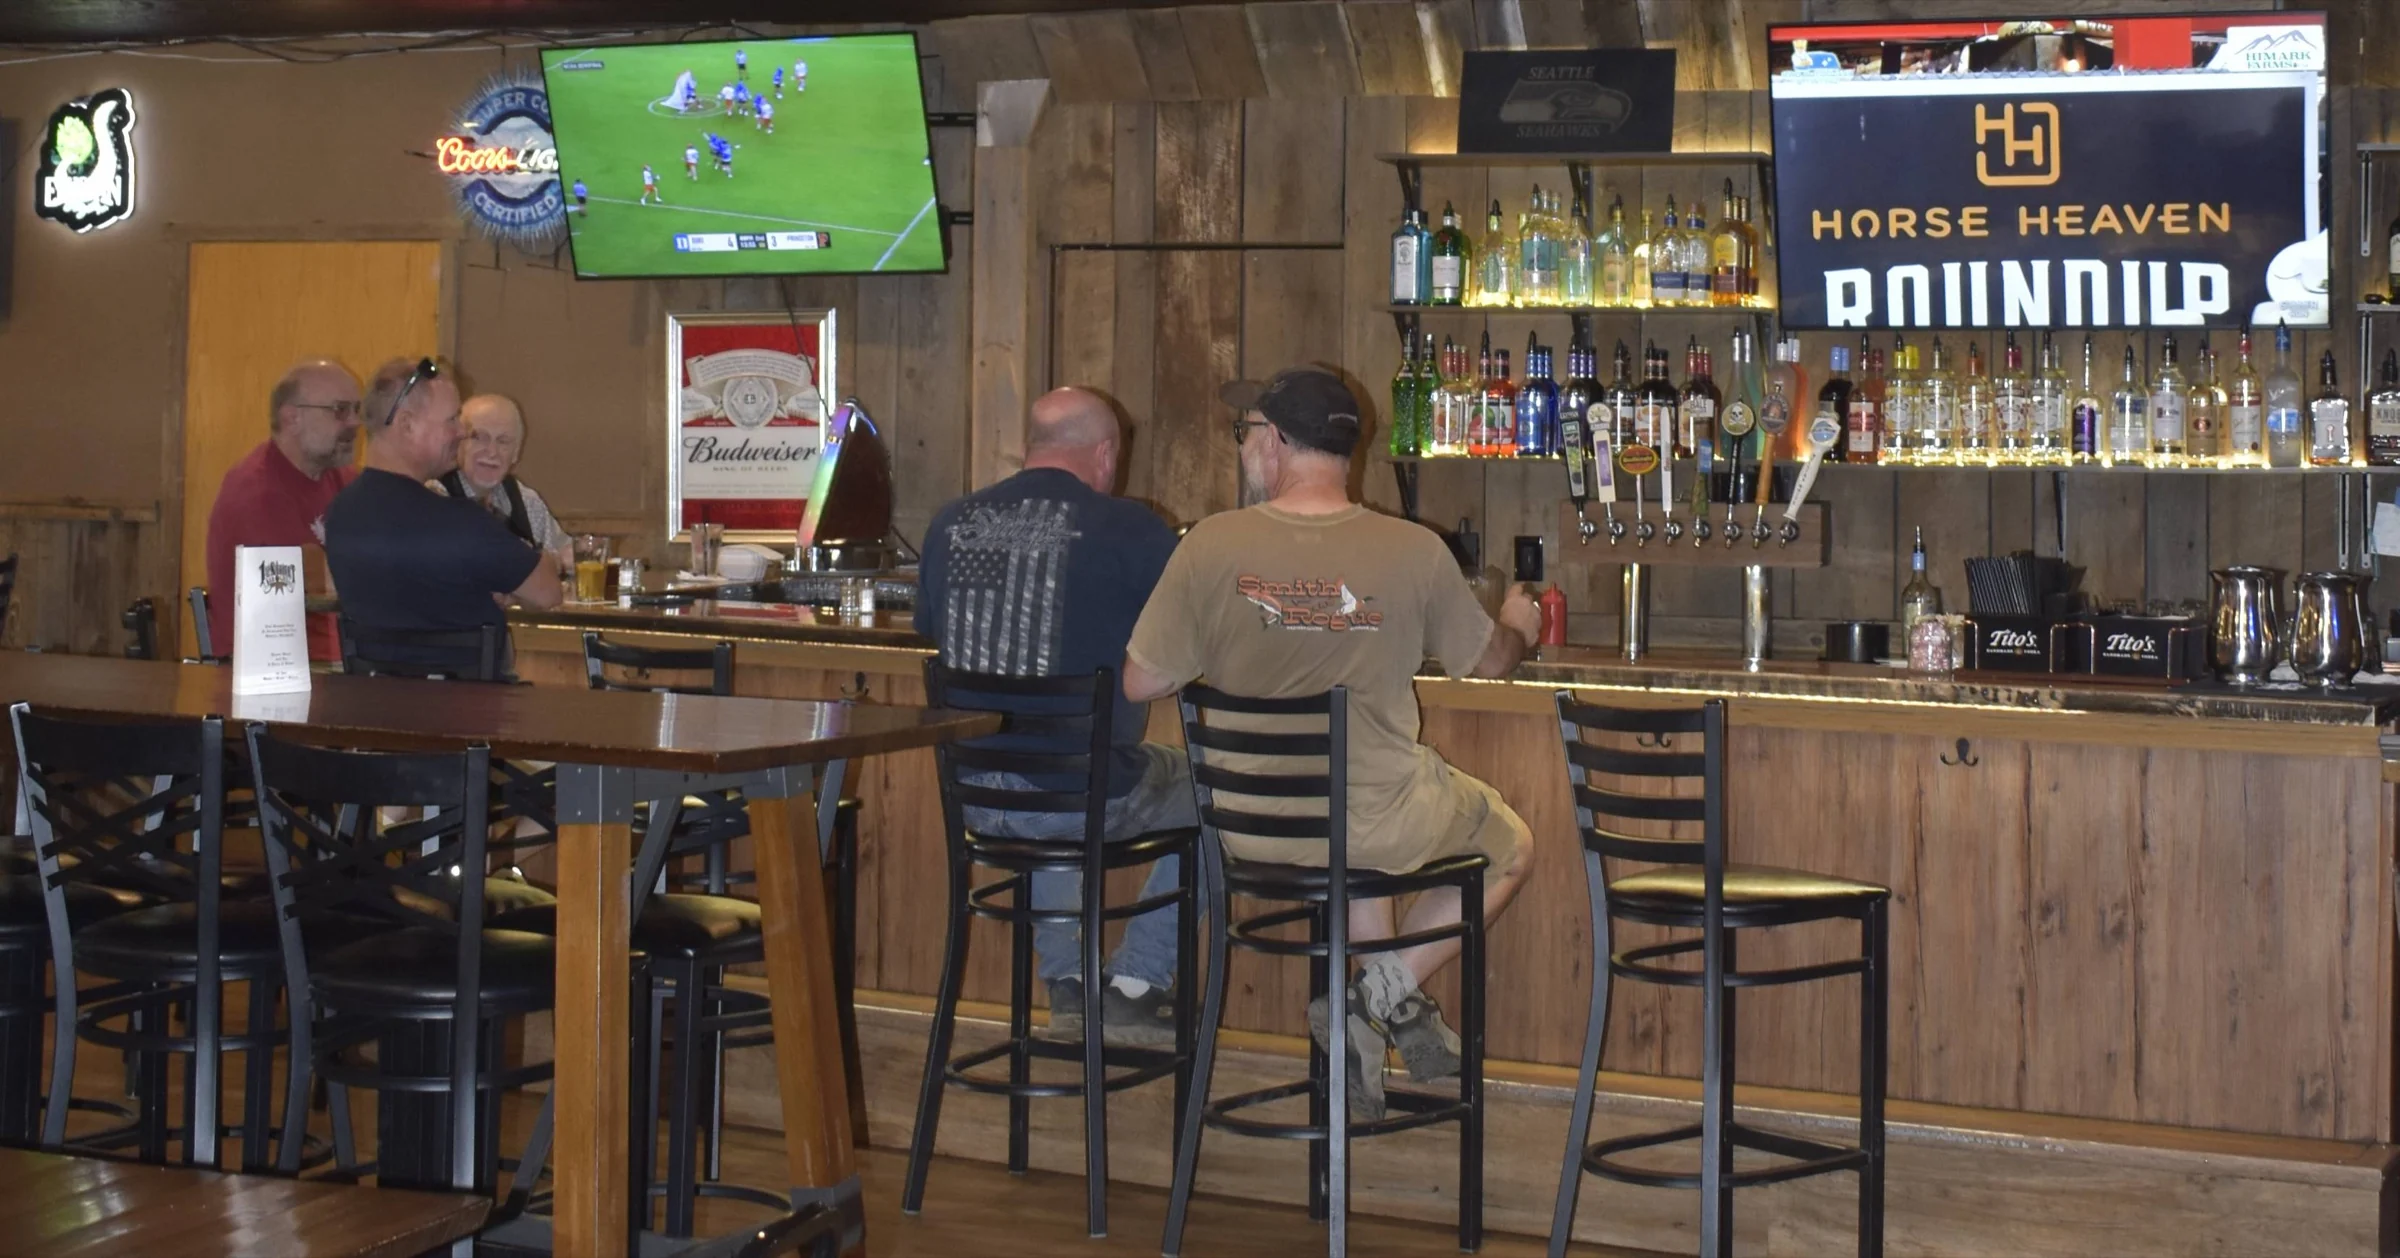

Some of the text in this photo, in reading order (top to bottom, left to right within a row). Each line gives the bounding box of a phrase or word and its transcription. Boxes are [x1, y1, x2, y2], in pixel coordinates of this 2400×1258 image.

[2246, 51, 2311, 61] HIMARK
[2247, 61, 2293, 69] FARMS
[1528, 66, 1595, 79] SEATTLE
[474, 92, 550, 125] SUPER CO
[1516, 124, 1600, 138] SEAHAWKS
[436, 137, 559, 172] Coors LIG
[474, 192, 557, 223] CERTIFIED
[1812, 202, 2230, 240] HORSE HEAVEN
[683, 436, 817, 463] Budweiser
[1237, 574, 1341, 597] Smith
[1281, 606, 1384, 631] Rogue
[1989, 628, 2037, 648] Tito's
[2106, 633, 2156, 652] Tito's
